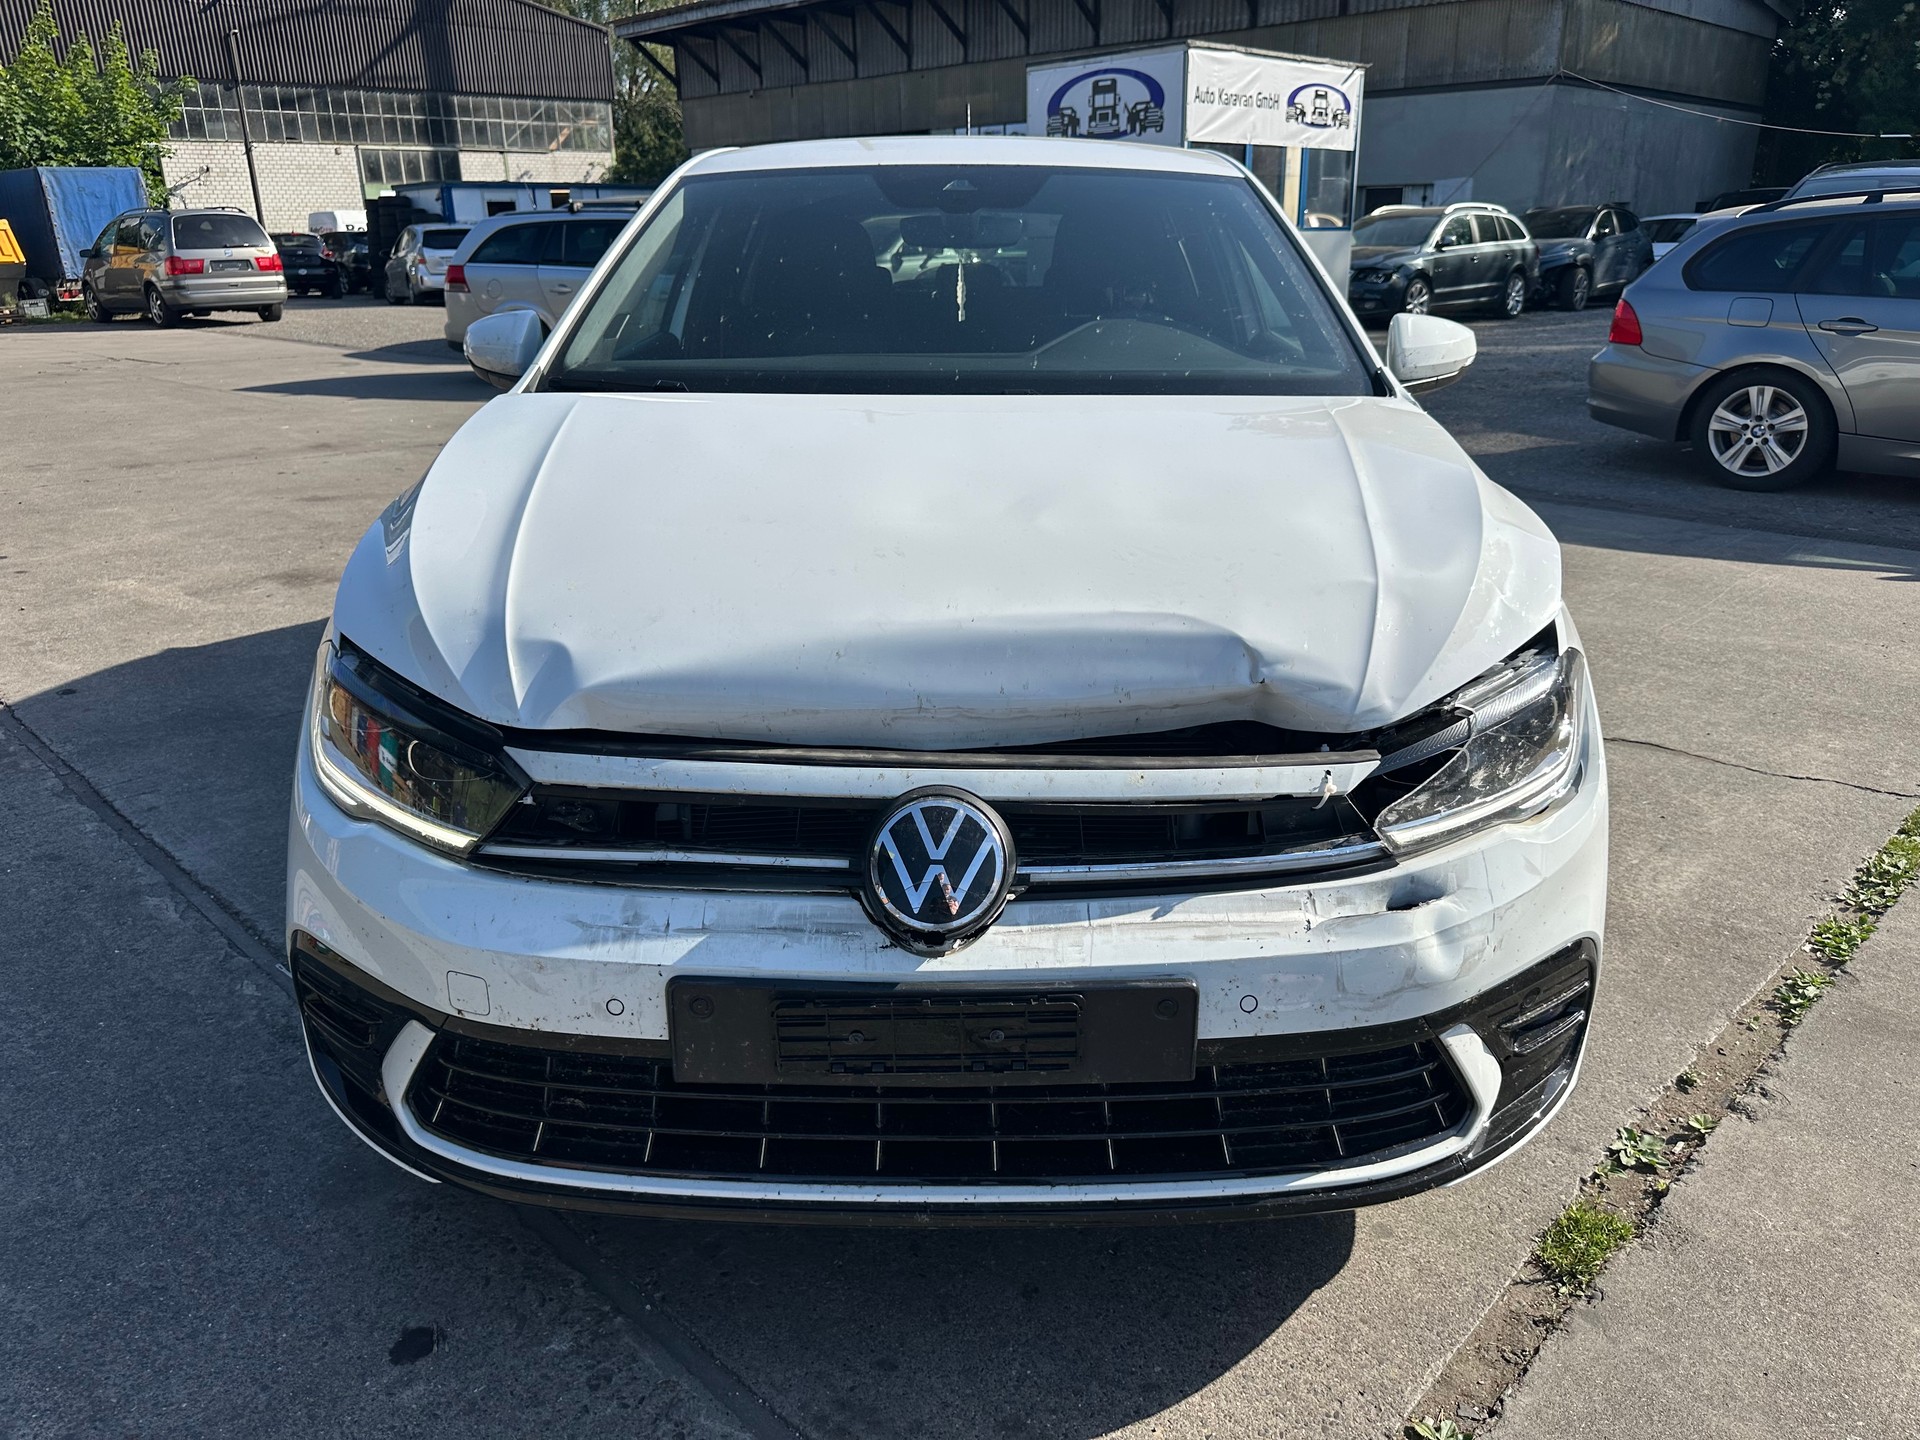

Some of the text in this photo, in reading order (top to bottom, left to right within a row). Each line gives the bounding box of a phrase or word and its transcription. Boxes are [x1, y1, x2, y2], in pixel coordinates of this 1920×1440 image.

[1194, 86, 1280, 110] Auto Karavan GmbH
[876, 803, 998, 916] VW
